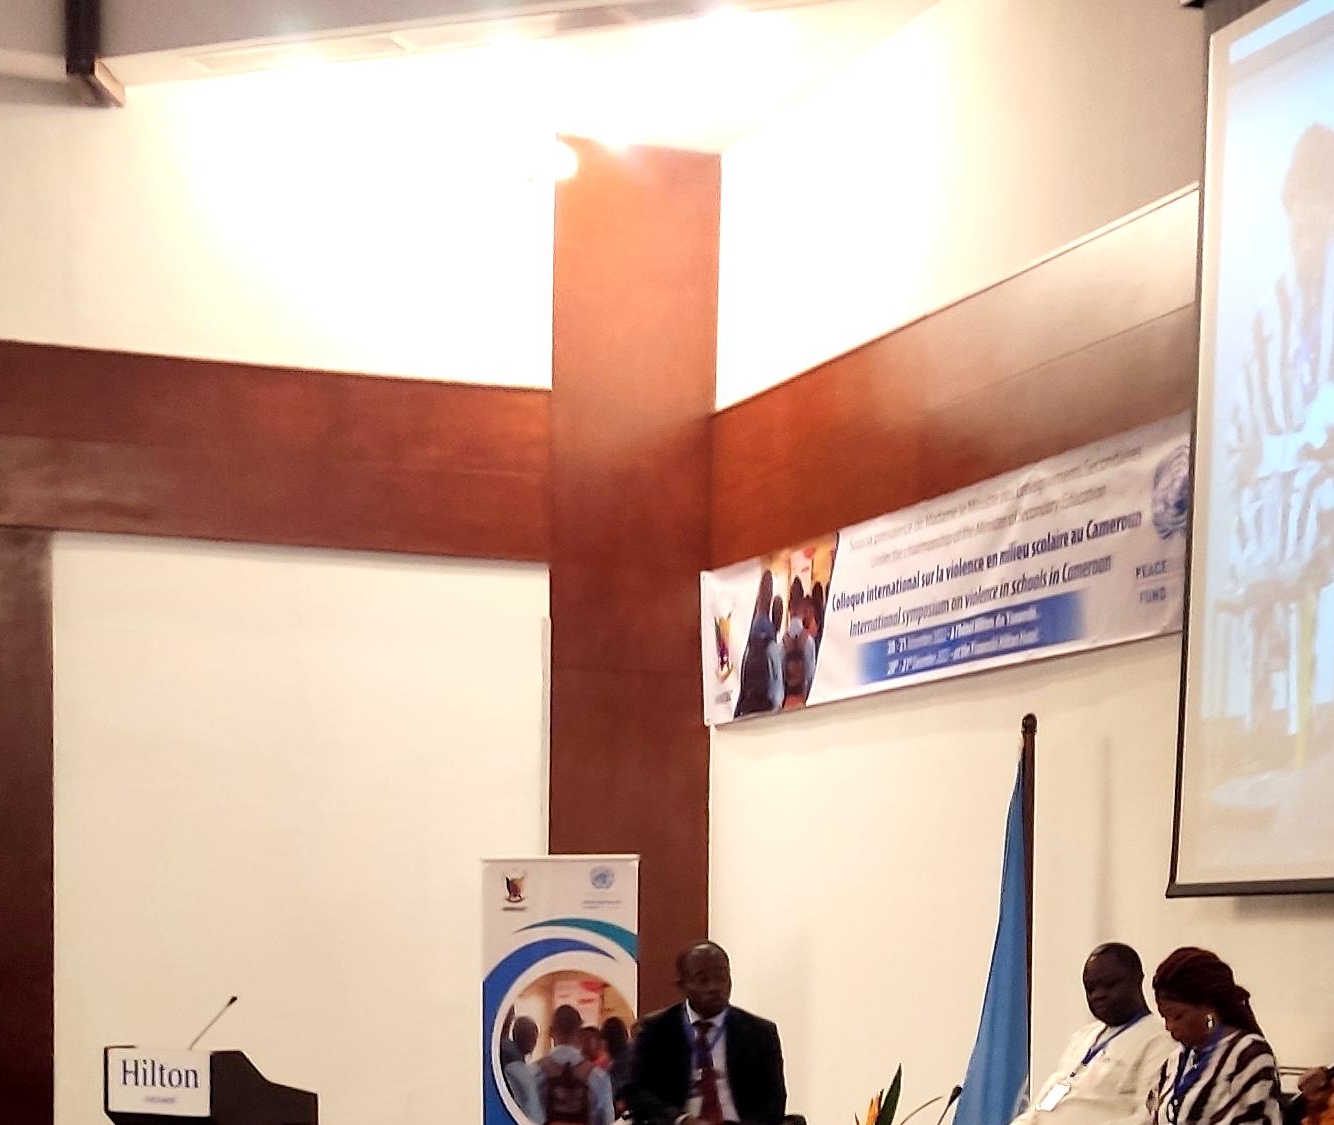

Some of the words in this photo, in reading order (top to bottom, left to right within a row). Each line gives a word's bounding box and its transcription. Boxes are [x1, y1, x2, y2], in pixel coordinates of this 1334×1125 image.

[832, 591, 865, 612] Colloque
[866, 570, 920, 603] international
[921, 570, 935, 588] sur
[936, 564, 944, 583] la
[946, 558, 985, 581] violence
[986, 552, 998, 569] en
[999, 541, 1030, 566] milieu
[1031, 531, 1069, 557] scolaire
[1070, 527, 1084, 546] au
[1086, 511, 1142, 541] Cameroun
[1135, 560, 1168, 579] PEACE
[850, 606, 902, 638] International
[902, 599, 950, 628] symposium
[951, 596, 963, 612] on
[965, 585, 998, 609] violence
[999, 582, 1010, 599] in
[1011, 568, 1047, 597] schools
[1048, 565, 1060, 587] in
[1062, 555, 1112, 584] Cameroon
[1139, 587, 1167, 604] FUND
[122, 1059, 199, 1089] Hilton
